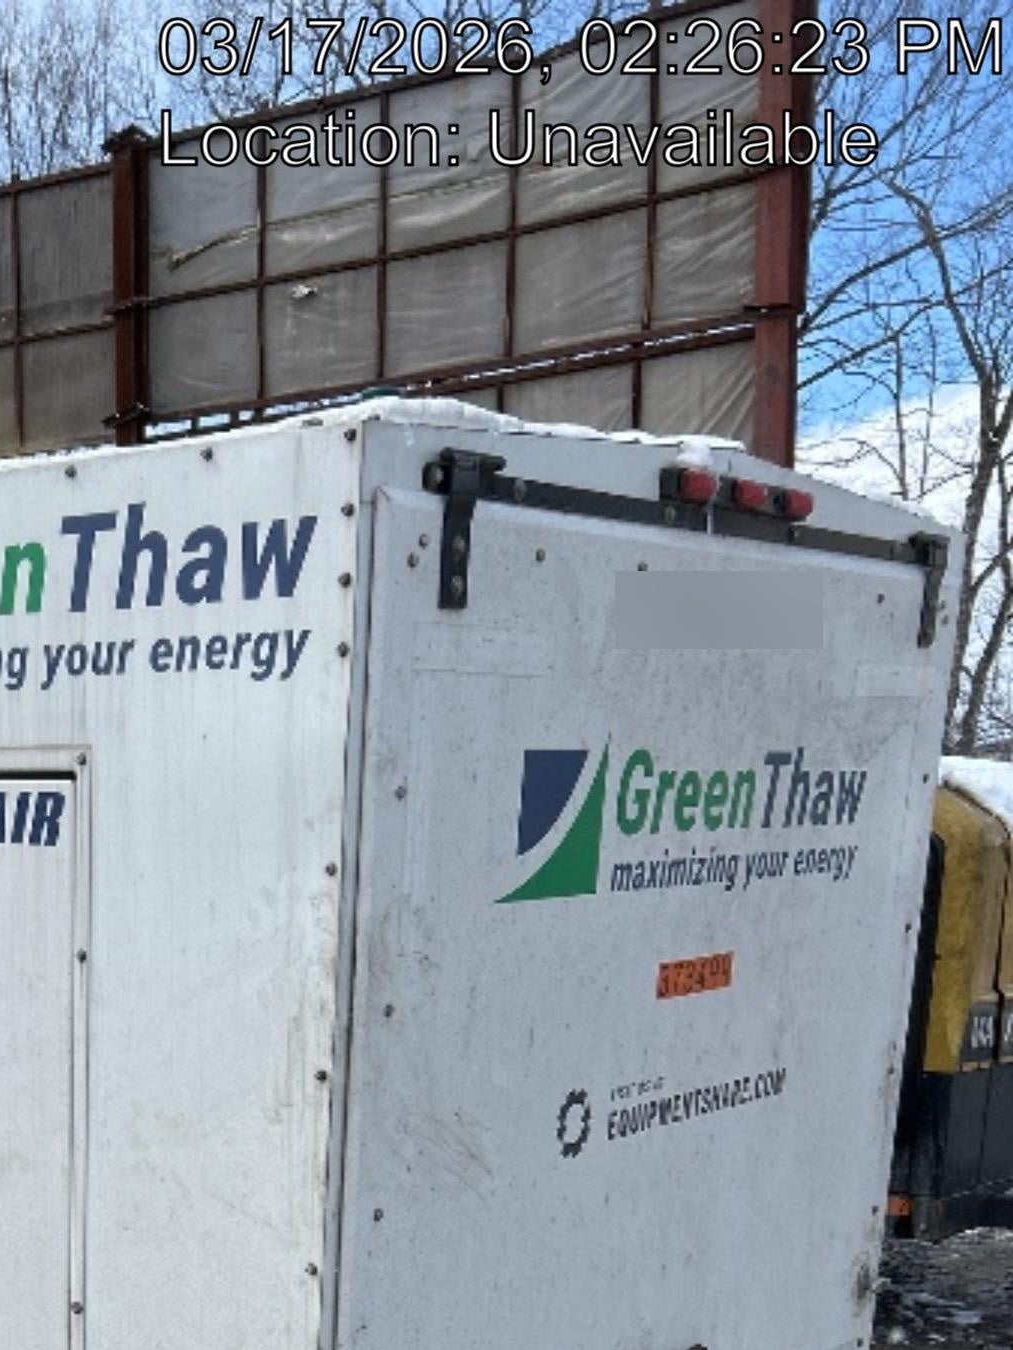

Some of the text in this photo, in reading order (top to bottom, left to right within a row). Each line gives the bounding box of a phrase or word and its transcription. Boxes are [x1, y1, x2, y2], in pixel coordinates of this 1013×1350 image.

[41, 638, 136, 691] your
[149, 629, 312, 682] energy
[610, 845, 858, 891] maximizing your energy
